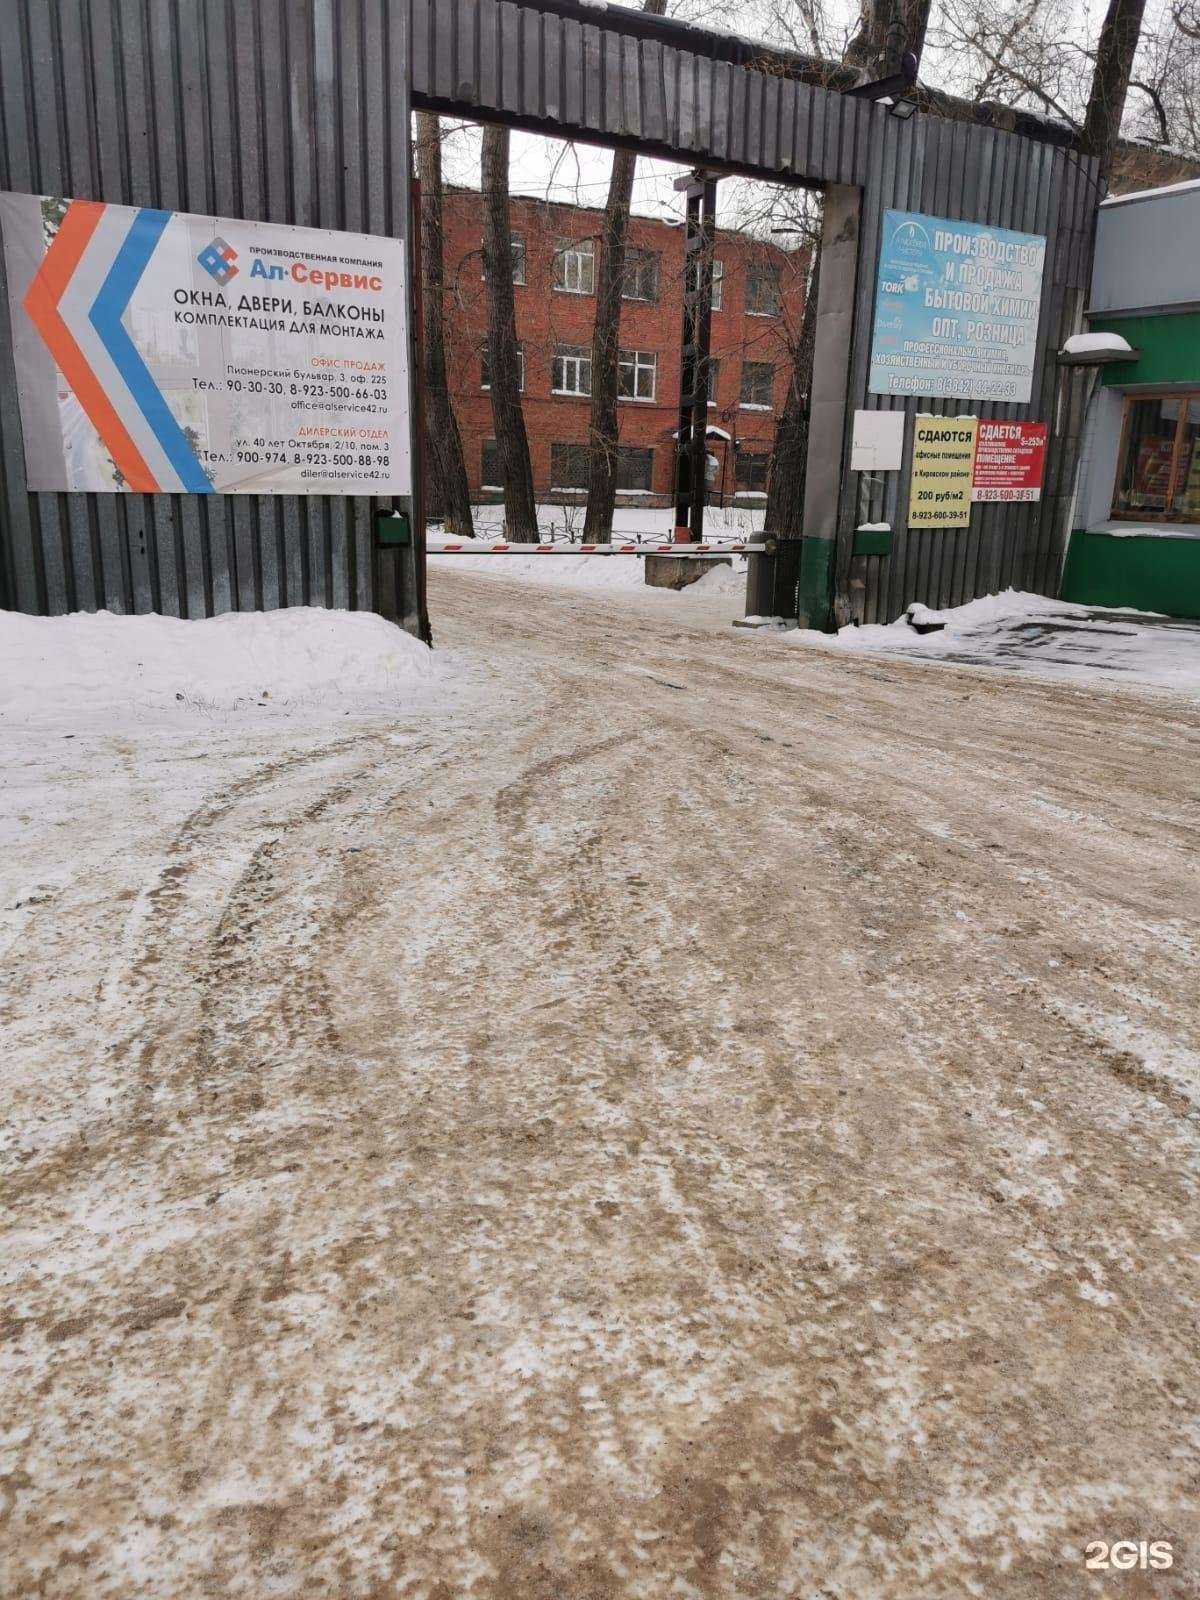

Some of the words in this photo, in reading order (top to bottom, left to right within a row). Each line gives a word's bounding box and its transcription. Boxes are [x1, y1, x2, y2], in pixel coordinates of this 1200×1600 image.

[934, 231, 1037, 267] ПРОИЗВОДСТВО
[249, 246, 337, 263] ПРОИЗВОДСТВЕННАЯ
[339, 257, 383, 269] КОМПАНИЯ
[945, 261, 955, 281] И
[959, 264, 1023, 291] ПРОДАЖА
[174, 289, 231, 311] ОКНА,
[238, 295, 297, 316] ДВЕРИ,
[303, 301, 385, 323] БАЛКОНЫ
[925, 287, 988, 312] БЫТОВОЙ
[174, 311, 285, 332] КОМПЛЕКТАЦИЯ
[289, 323, 316, 335] ДЛЯ
[320, 324, 385, 340] МОНТАЖА
[967, 320, 1024, 347] РОЗНИЦА
[311, 358, 340, 368] ОФИС
[344, 360, 385, 371] ПРОДАЖ
[227, 365, 291, 378] Пионерский
[371, 375, 387, 384] 225
[192, 378, 222, 390] Тел.:
[227, 380, 286, 396] 90-30-30,
[290, 384, 387, 400] 8-923-500-66-03
[291, 400, 388, 413] office@alservice42.ru
[298, 427, 356, 438] ДИЛЕРСКИЙ
[360, 429, 389, 439] ОТДЕЛ
[918, 430, 972, 443] СДАЮТСЯ
[980, 424, 1022, 440] СДАЕТСЯ
[236, 439, 250, 449] ул.
[254, 438, 265, 447] 40
[268, 440, 285, 448] лет
[384, 443, 389, 451] 3
[204, 451, 232, 462] Тел.:
[294, 453, 389, 466] 8-923-500-88-98
[301, 469, 390, 479] diler@alservice42.ru
[918, 491, 933, 500] 200
[912, 511, 967, 520] 8-923-600-39-51
